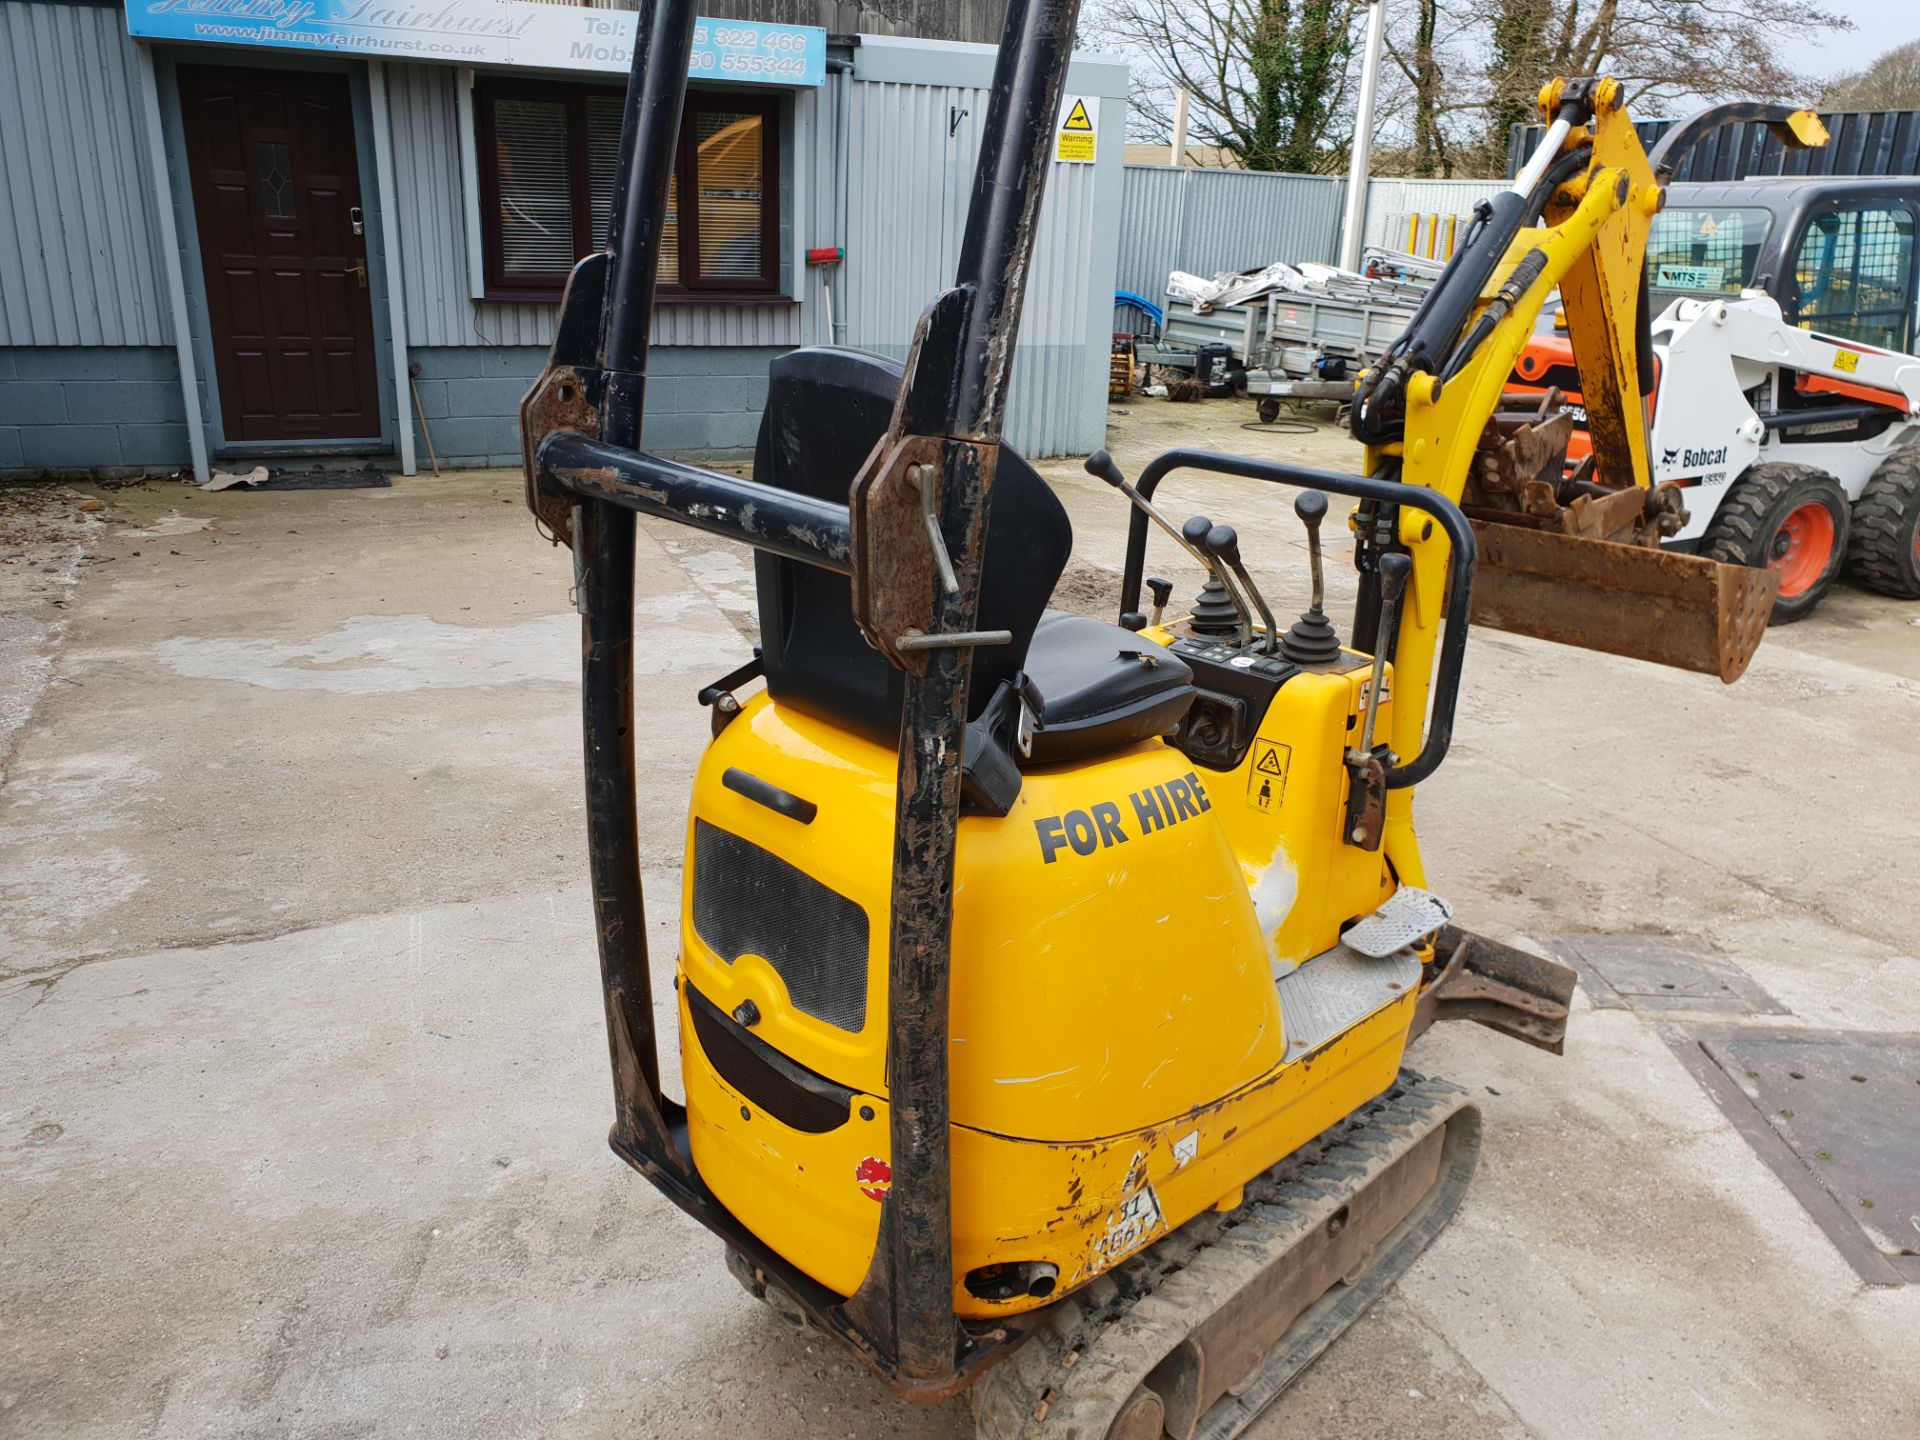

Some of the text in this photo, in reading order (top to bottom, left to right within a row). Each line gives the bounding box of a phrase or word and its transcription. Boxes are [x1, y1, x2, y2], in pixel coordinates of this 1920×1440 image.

[334, 0, 536, 36] Fairhurst
[583, 16, 627, 37] Tel:
[714, 28, 758, 48] 322
[764, 33, 806, 52] 466
[195, 23, 487, 57] www.jimmyfairhurst.co.uk
[568, 42, 634, 63] Mob:
[721, 54, 807, 76] 555344
[1061, 133, 1093, 144] Warning
[1671, 271, 1696, 282] MTS
[1683, 446, 1727, 468] Bobcat
[1034, 771, 1212, 864] FOR HIRE
